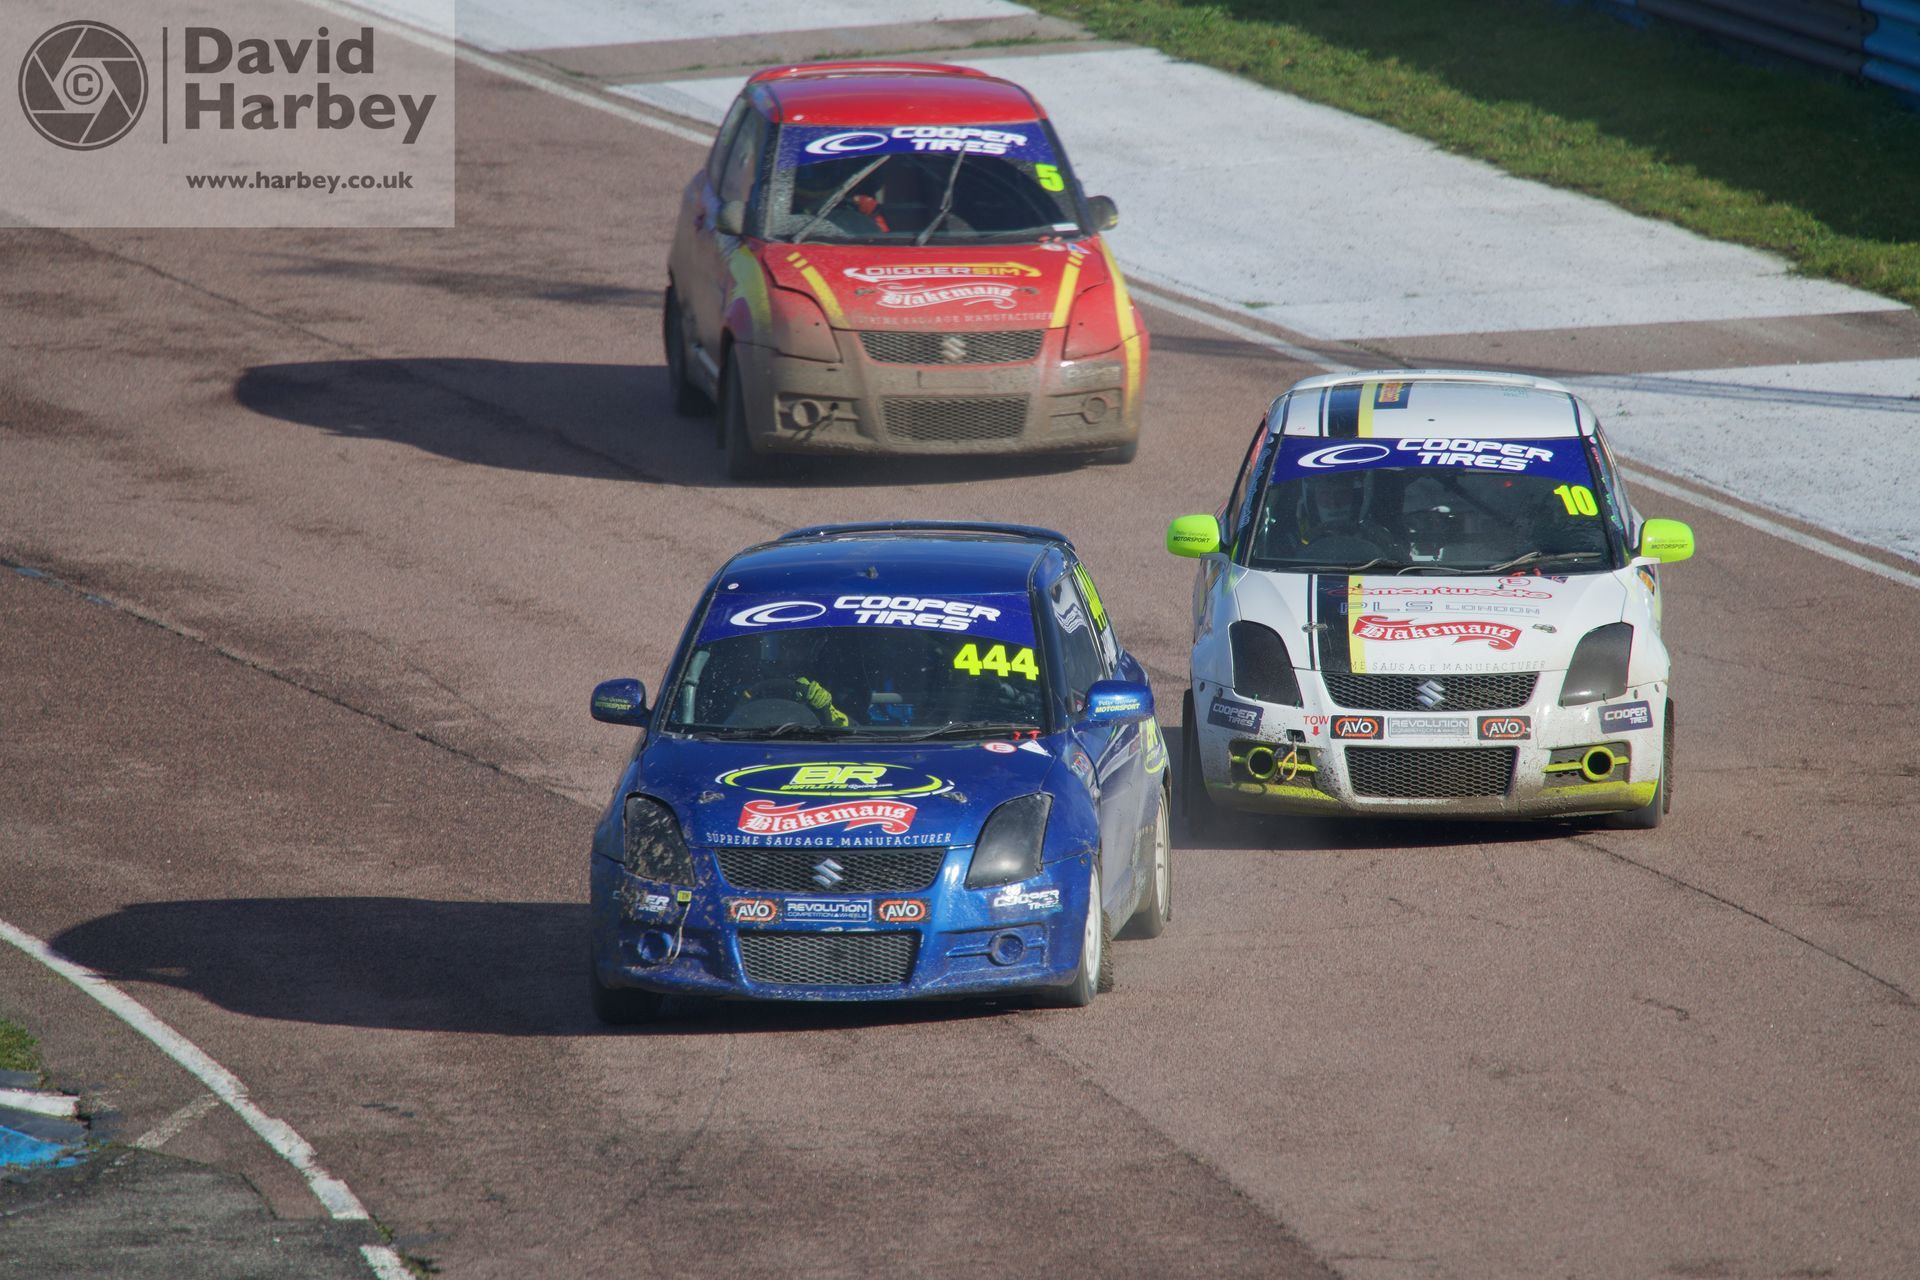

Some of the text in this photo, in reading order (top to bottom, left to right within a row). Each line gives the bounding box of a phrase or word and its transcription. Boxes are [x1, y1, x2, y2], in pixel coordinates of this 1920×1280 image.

[891, 126, 1028, 146] COOPER
[910, 138, 1008, 155] TIRES
[1035, 164, 1065, 192] 5
[865, 265, 1023, 278] DIGGERSIM
[1396, 438, 1554, 462] COOPER
[1417, 452, 1531, 471] TIRES
[1553, 485, 1598, 516] 10
[833, 595, 1001, 622] COOPER
[1445, 604, 1541, 615] LONDON
[854, 610, 973, 631] TIRES
[1357, 621, 1517, 641] Blakemans
[953, 643, 1040, 681] 444
[1372, 661, 1436, 672] SAUSAGE
[1443, 660, 1546, 671] MANUFACTURER
[1213, 703, 1257, 721] COOPER
[1303, 715, 1329, 725] TOW
[1604, 707, 1648, 721] COOPER
[1227, 715, 1254, 728] TIRES
[1341, 719, 1374, 736] AVO
[1391, 719, 1468, 728] REVOLUTION
[1487, 719, 1520, 737] AVO
[789, 766, 888, 785] BR
[743, 805, 910, 832] Blakemans
[706, 831, 952, 846] SUPREME SAUSAGE MANUFACTURER
[736, 901, 770, 922] AVO
[787, 903, 867, 913] REVOLUTION
[886, 901, 919, 921] AVO
